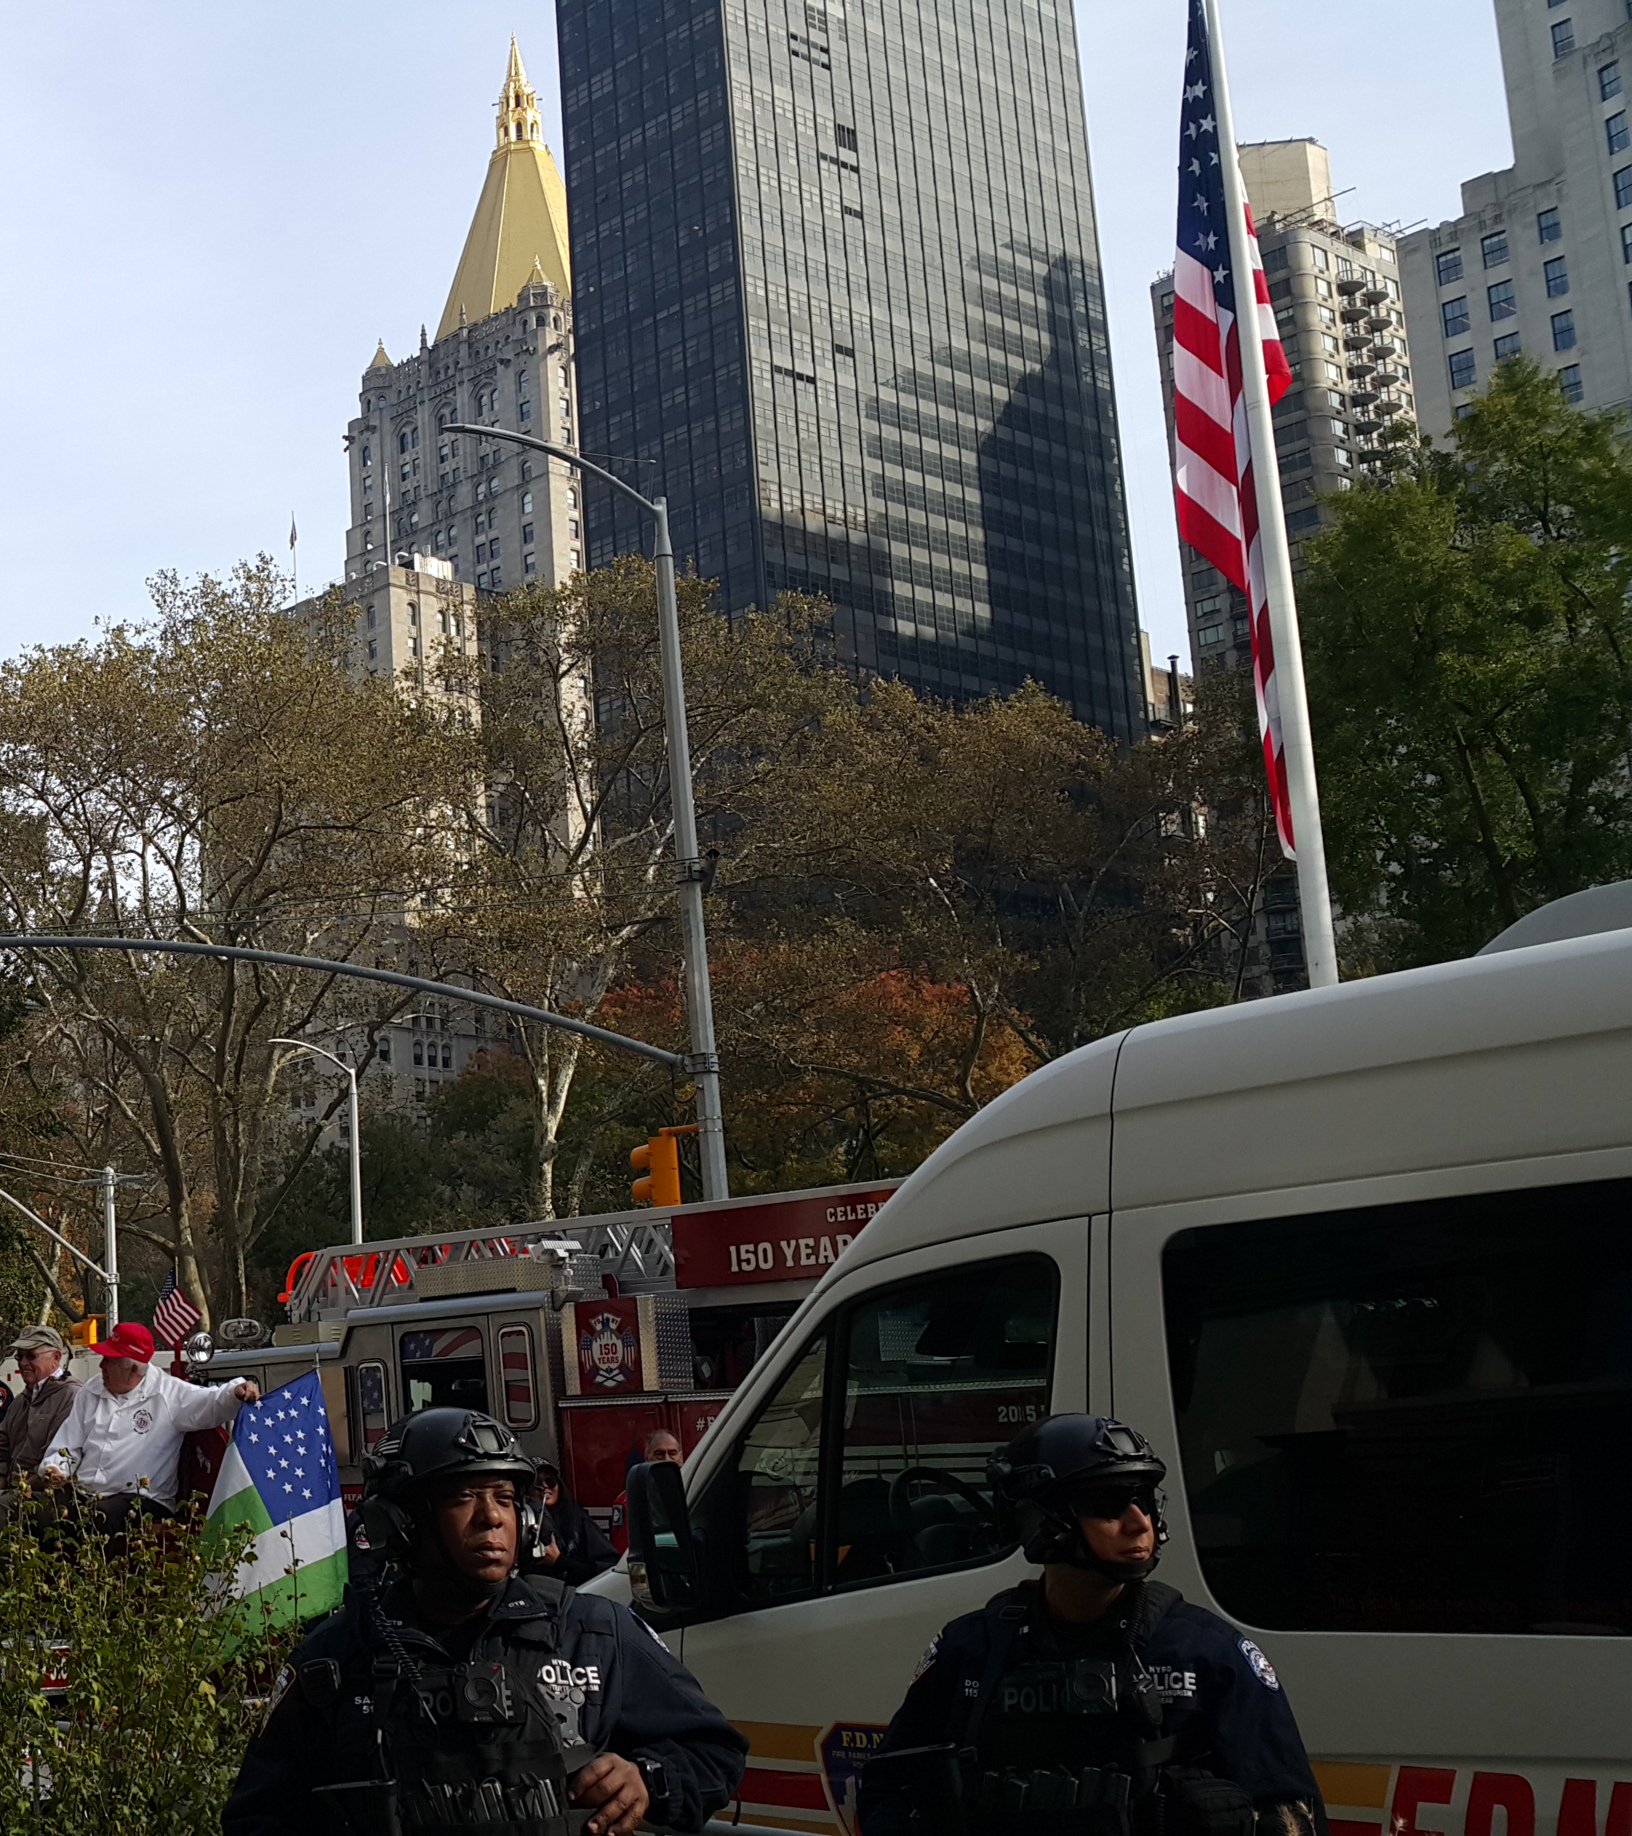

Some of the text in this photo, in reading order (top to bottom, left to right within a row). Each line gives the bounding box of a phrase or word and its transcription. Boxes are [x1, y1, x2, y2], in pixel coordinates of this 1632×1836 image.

[729, 1242, 774, 1272] 150
[599, 1342, 618, 1356] 150
[598, 1356, 620, 1365] YEARS
[537, 1665, 601, 1687] OLICE
[1149, 1665, 1172, 1674] NYPD
[1153, 1671, 1197, 1691] LICE
[841, 1730, 885, 1749] F.D.N
